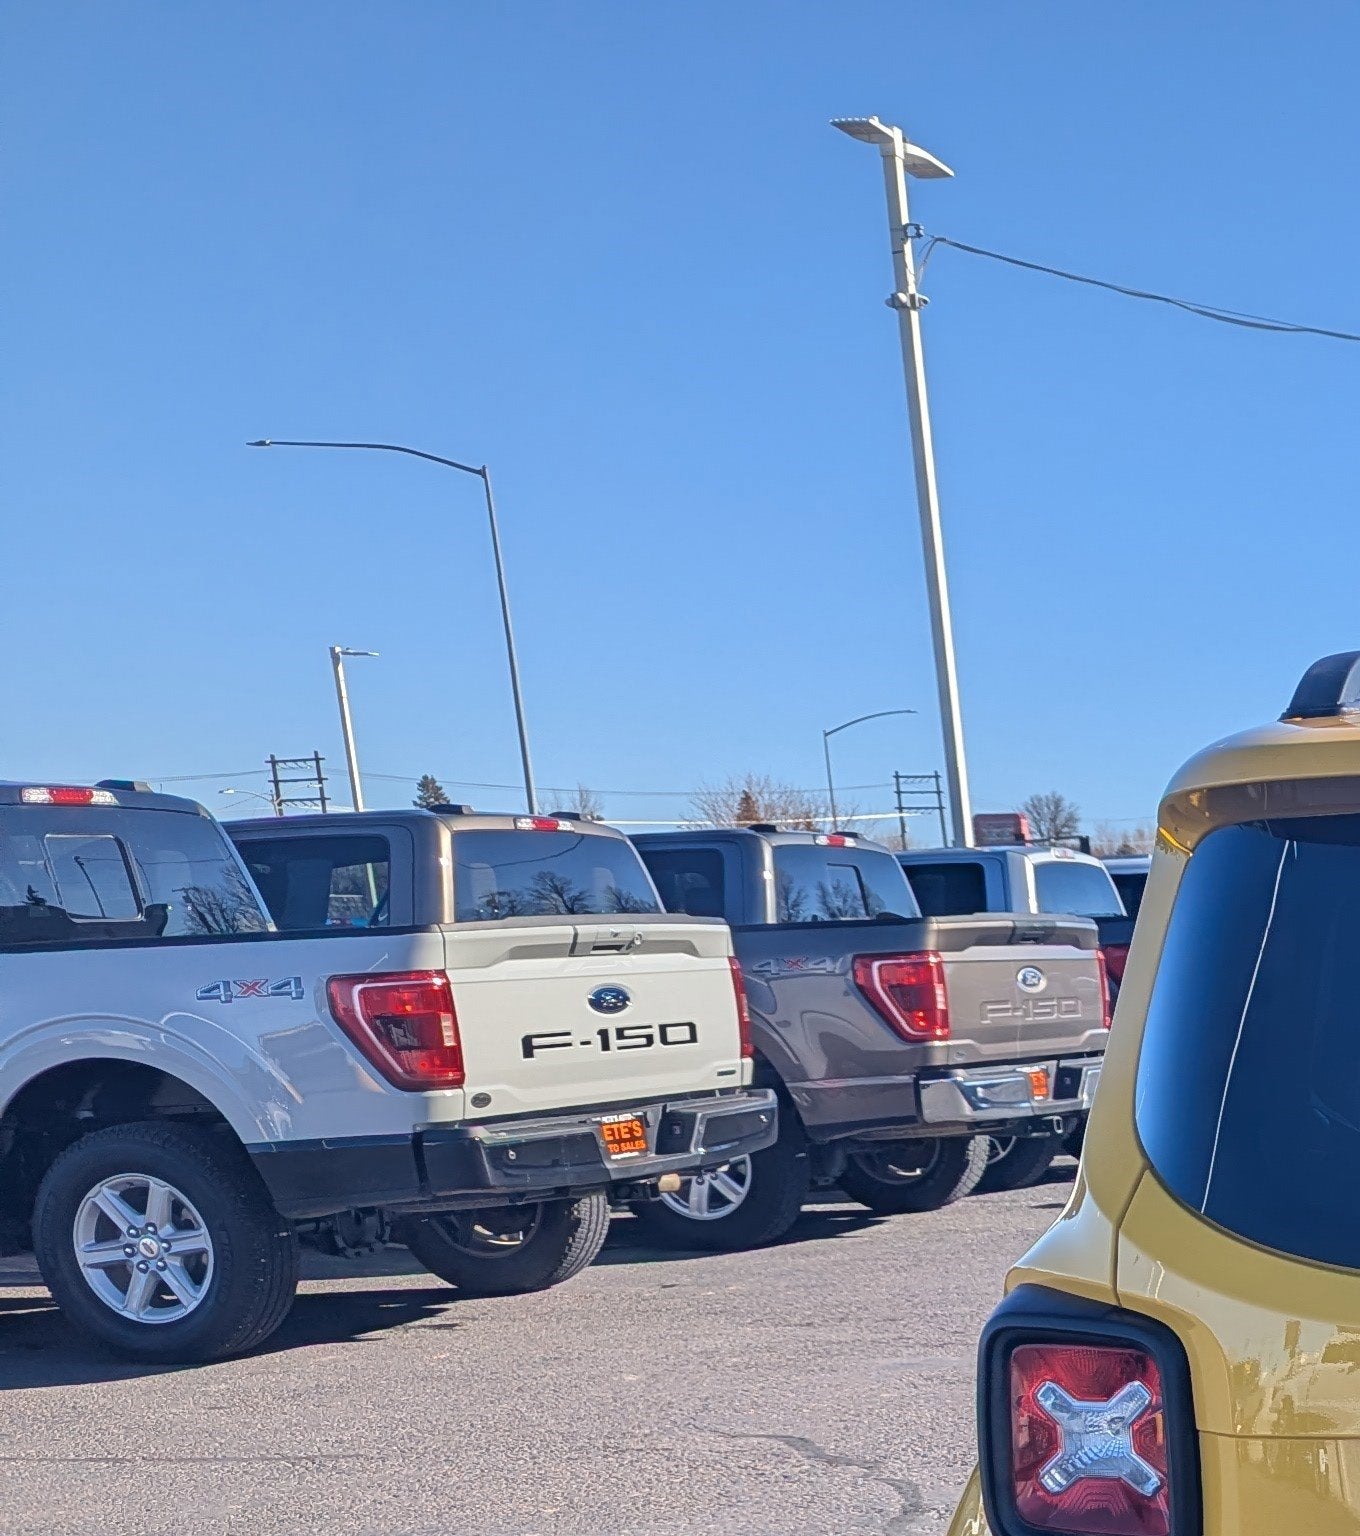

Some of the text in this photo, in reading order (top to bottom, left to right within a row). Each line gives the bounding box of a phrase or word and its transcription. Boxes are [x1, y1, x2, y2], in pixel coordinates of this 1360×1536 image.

[980, 997, 1082, 1024] F-150
[521, 1021, 698, 1060] F-150
[602, 1120, 643, 1141] ETE'S
